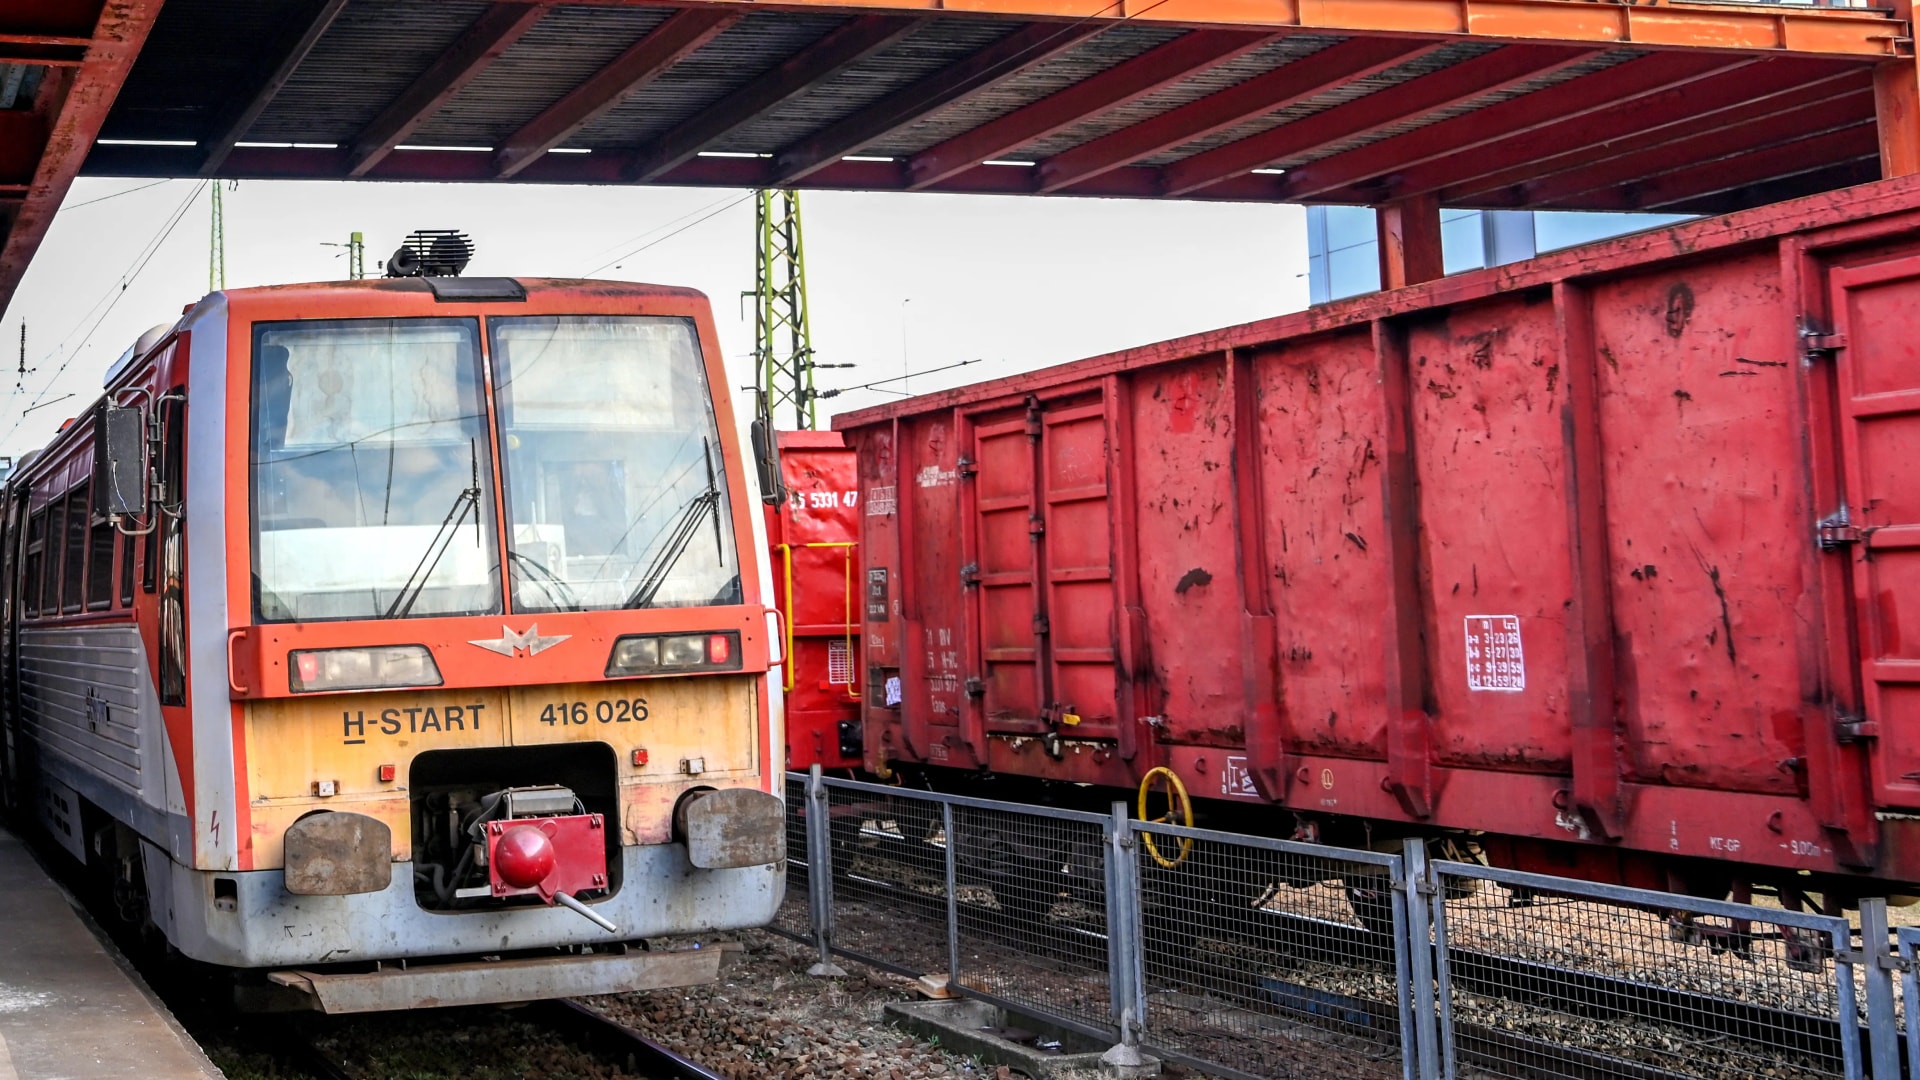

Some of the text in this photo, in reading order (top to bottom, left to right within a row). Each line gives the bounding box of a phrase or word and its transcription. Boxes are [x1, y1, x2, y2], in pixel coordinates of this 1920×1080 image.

[810, 491, 838, 508] 5331
[1484, 632, 1490, 644] 3
[1494, 632, 1504, 644] 23
[1484, 647, 1491, 658] 5
[1495, 647, 1505, 658] 27
[1485, 661, 1492, 673] 9
[1497, 661, 1507, 673] 39
[1482, 675, 1493, 687] 12
[1497, 675, 1508, 687] 59
[540, 698, 649, 727] 416 026
[343, 704, 485, 740] H-START
